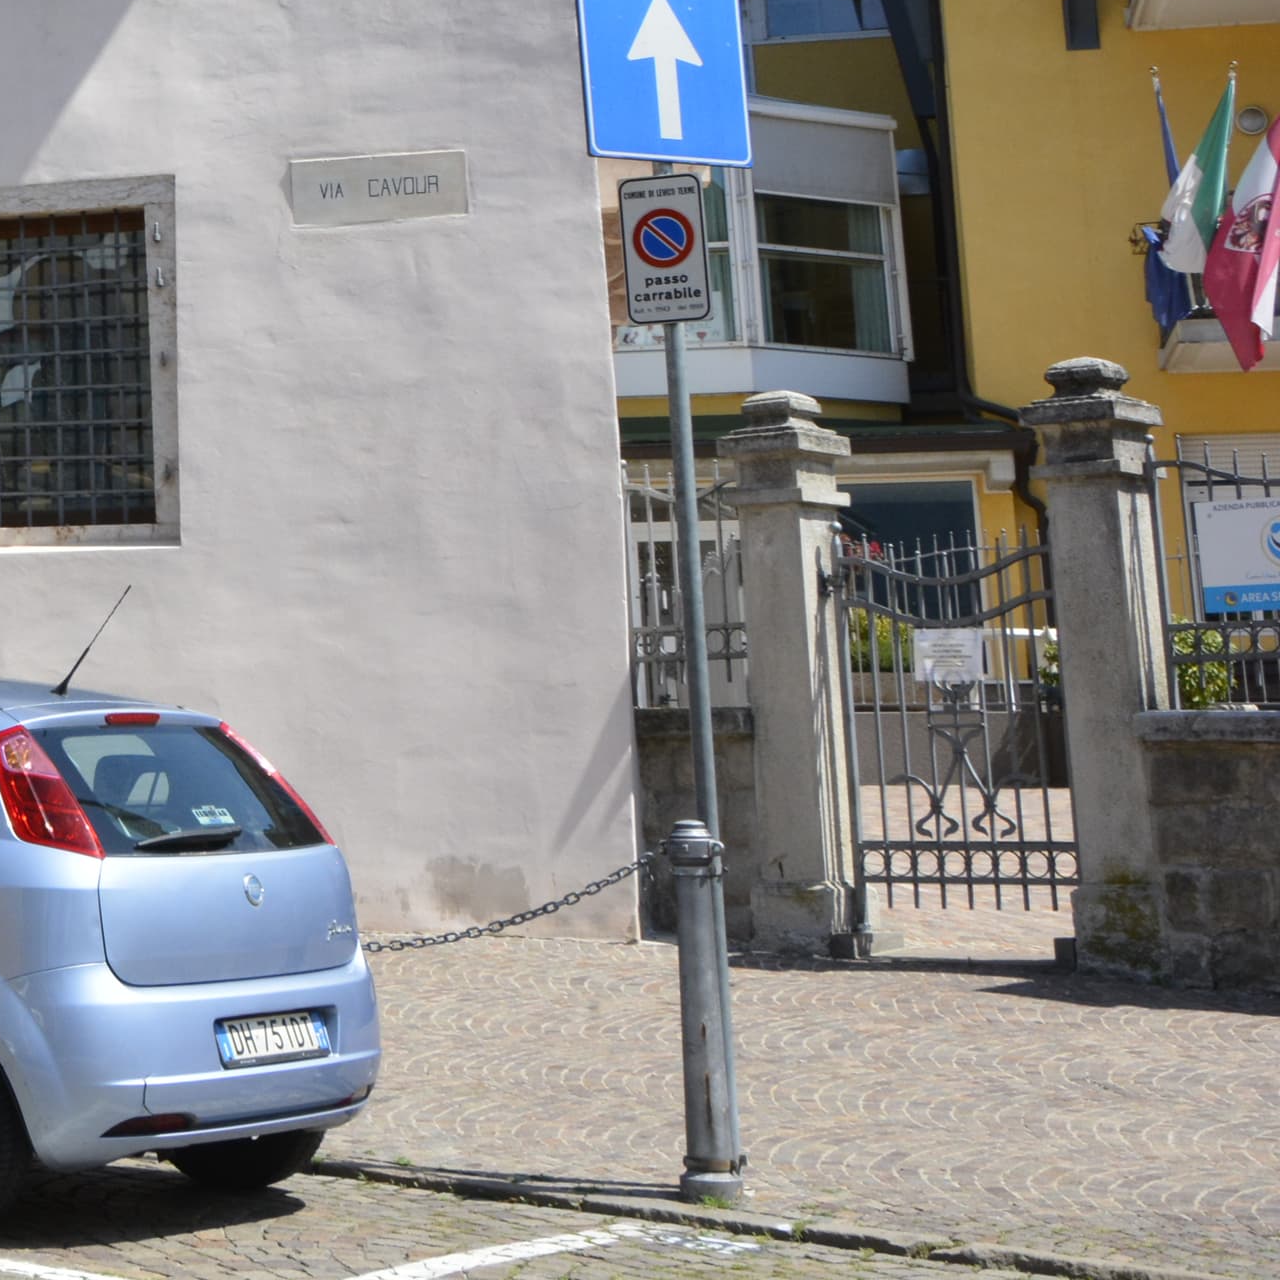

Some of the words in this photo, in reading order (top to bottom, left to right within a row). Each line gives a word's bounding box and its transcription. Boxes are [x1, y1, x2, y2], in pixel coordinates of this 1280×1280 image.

[320, 183, 344, 199] VIA
[368, 175, 439, 197] CAVOUR
[645, 274, 689, 288] passo
[634, 287, 702, 302] carrabile
[1241, 592, 1270, 602] AREA
[228, 1022, 258, 1056] DH
[256, 1015, 315, 1053] 751DT
